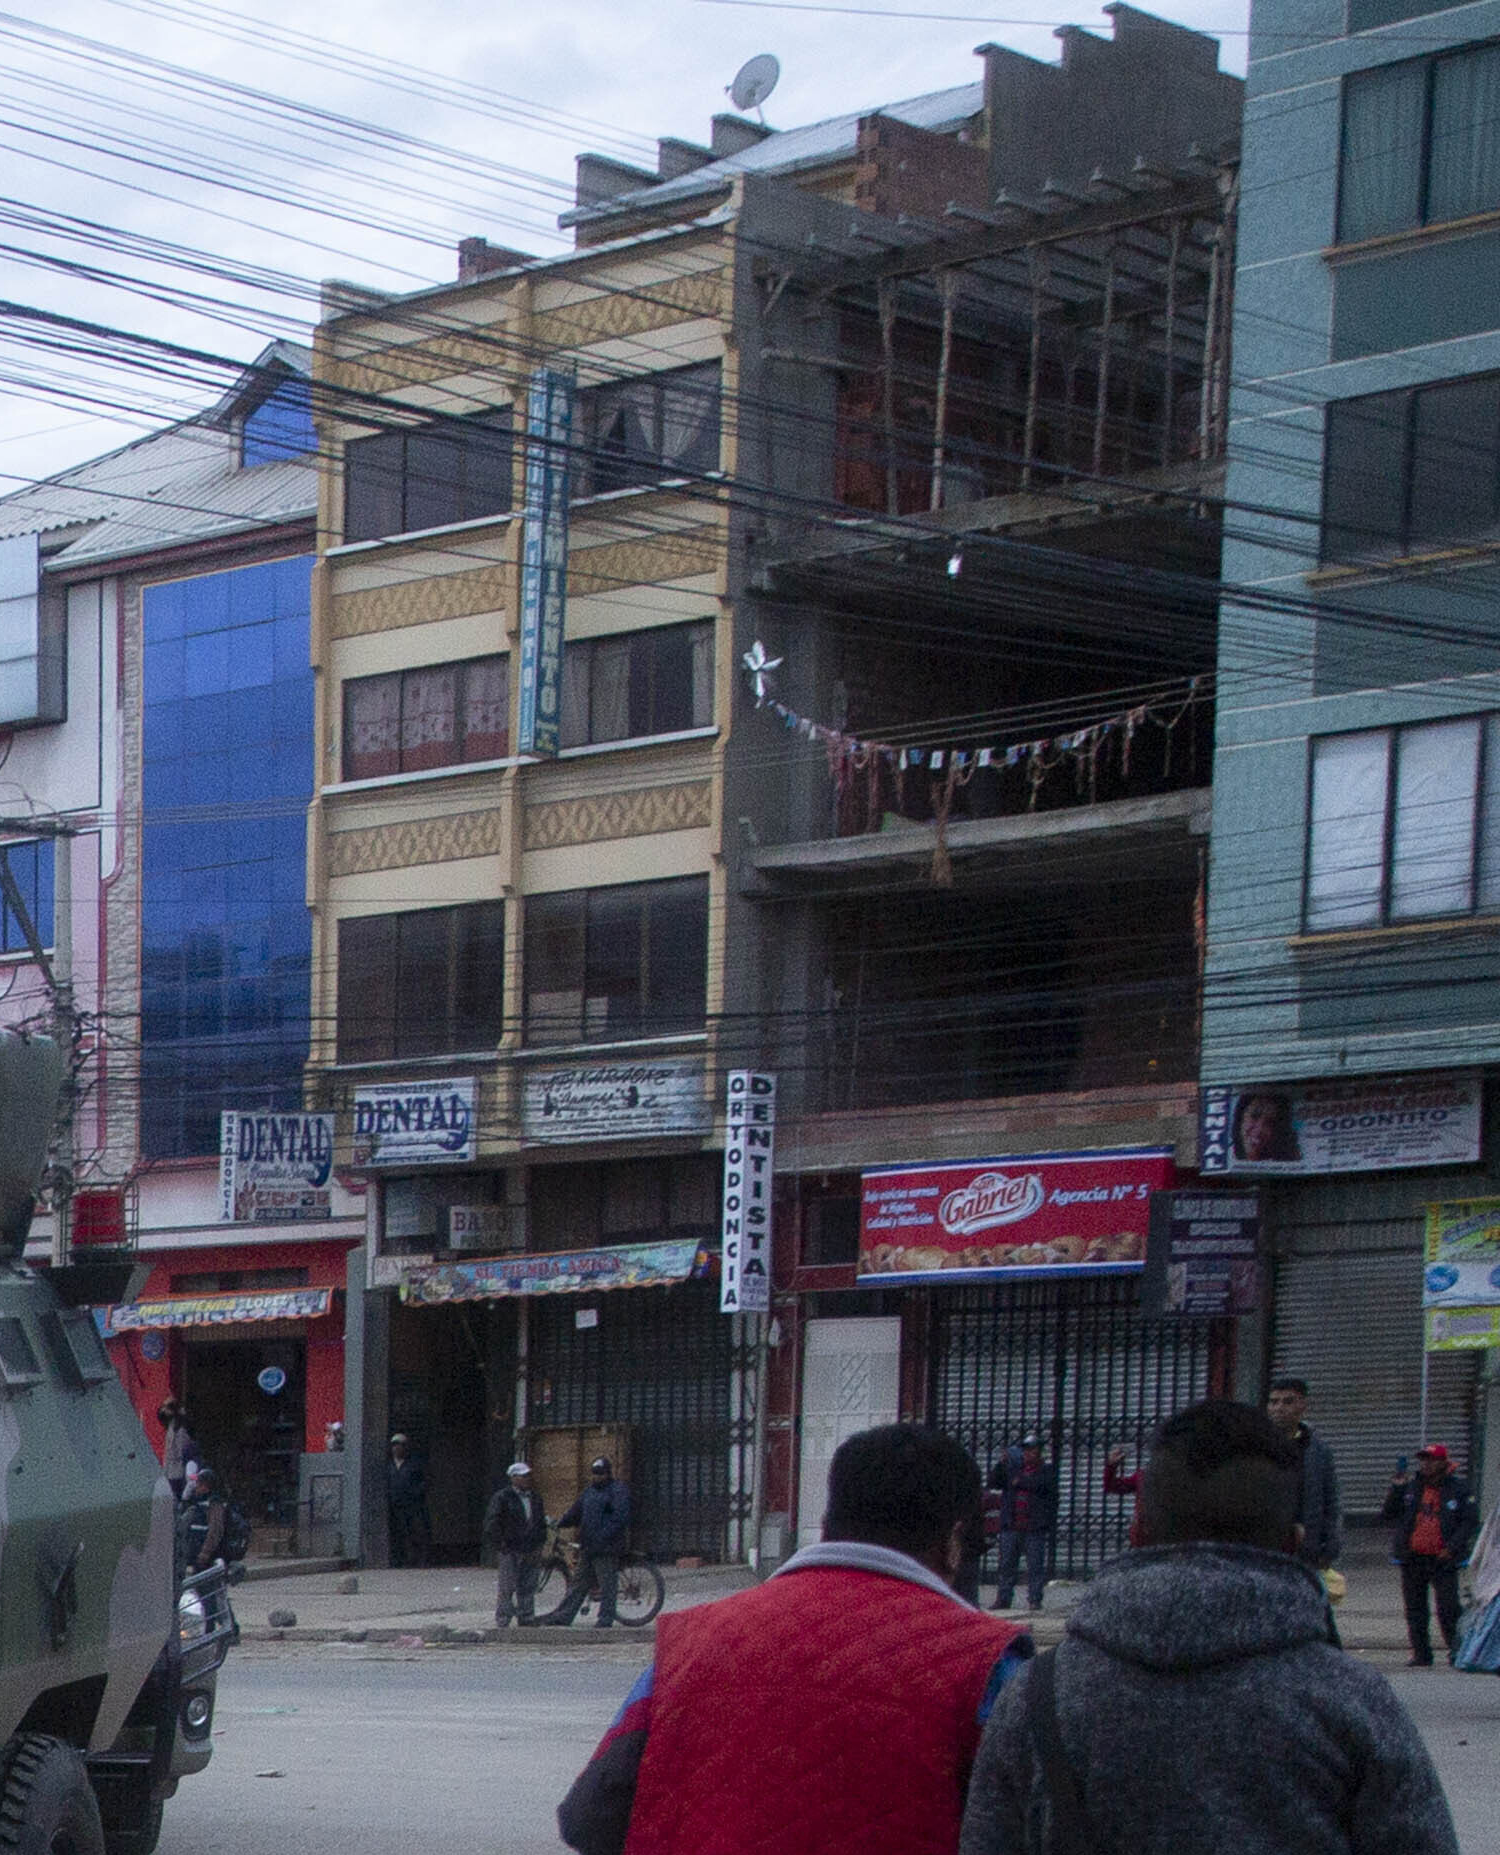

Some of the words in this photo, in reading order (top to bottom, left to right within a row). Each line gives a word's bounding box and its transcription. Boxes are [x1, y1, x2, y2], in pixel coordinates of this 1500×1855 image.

[355, 1094, 466, 1135] DENTAL
[239, 1117, 327, 1163] DENTAL
[723, 1077, 745, 1305] ORTODONCIA
[743, 1077, 772, 1277] DENTISTA
[942, 1174, 1030, 1226] Gabriel
[1049, 1187, 1108, 1208] Agencia
[1136, 1184, 1149, 1200] 5
